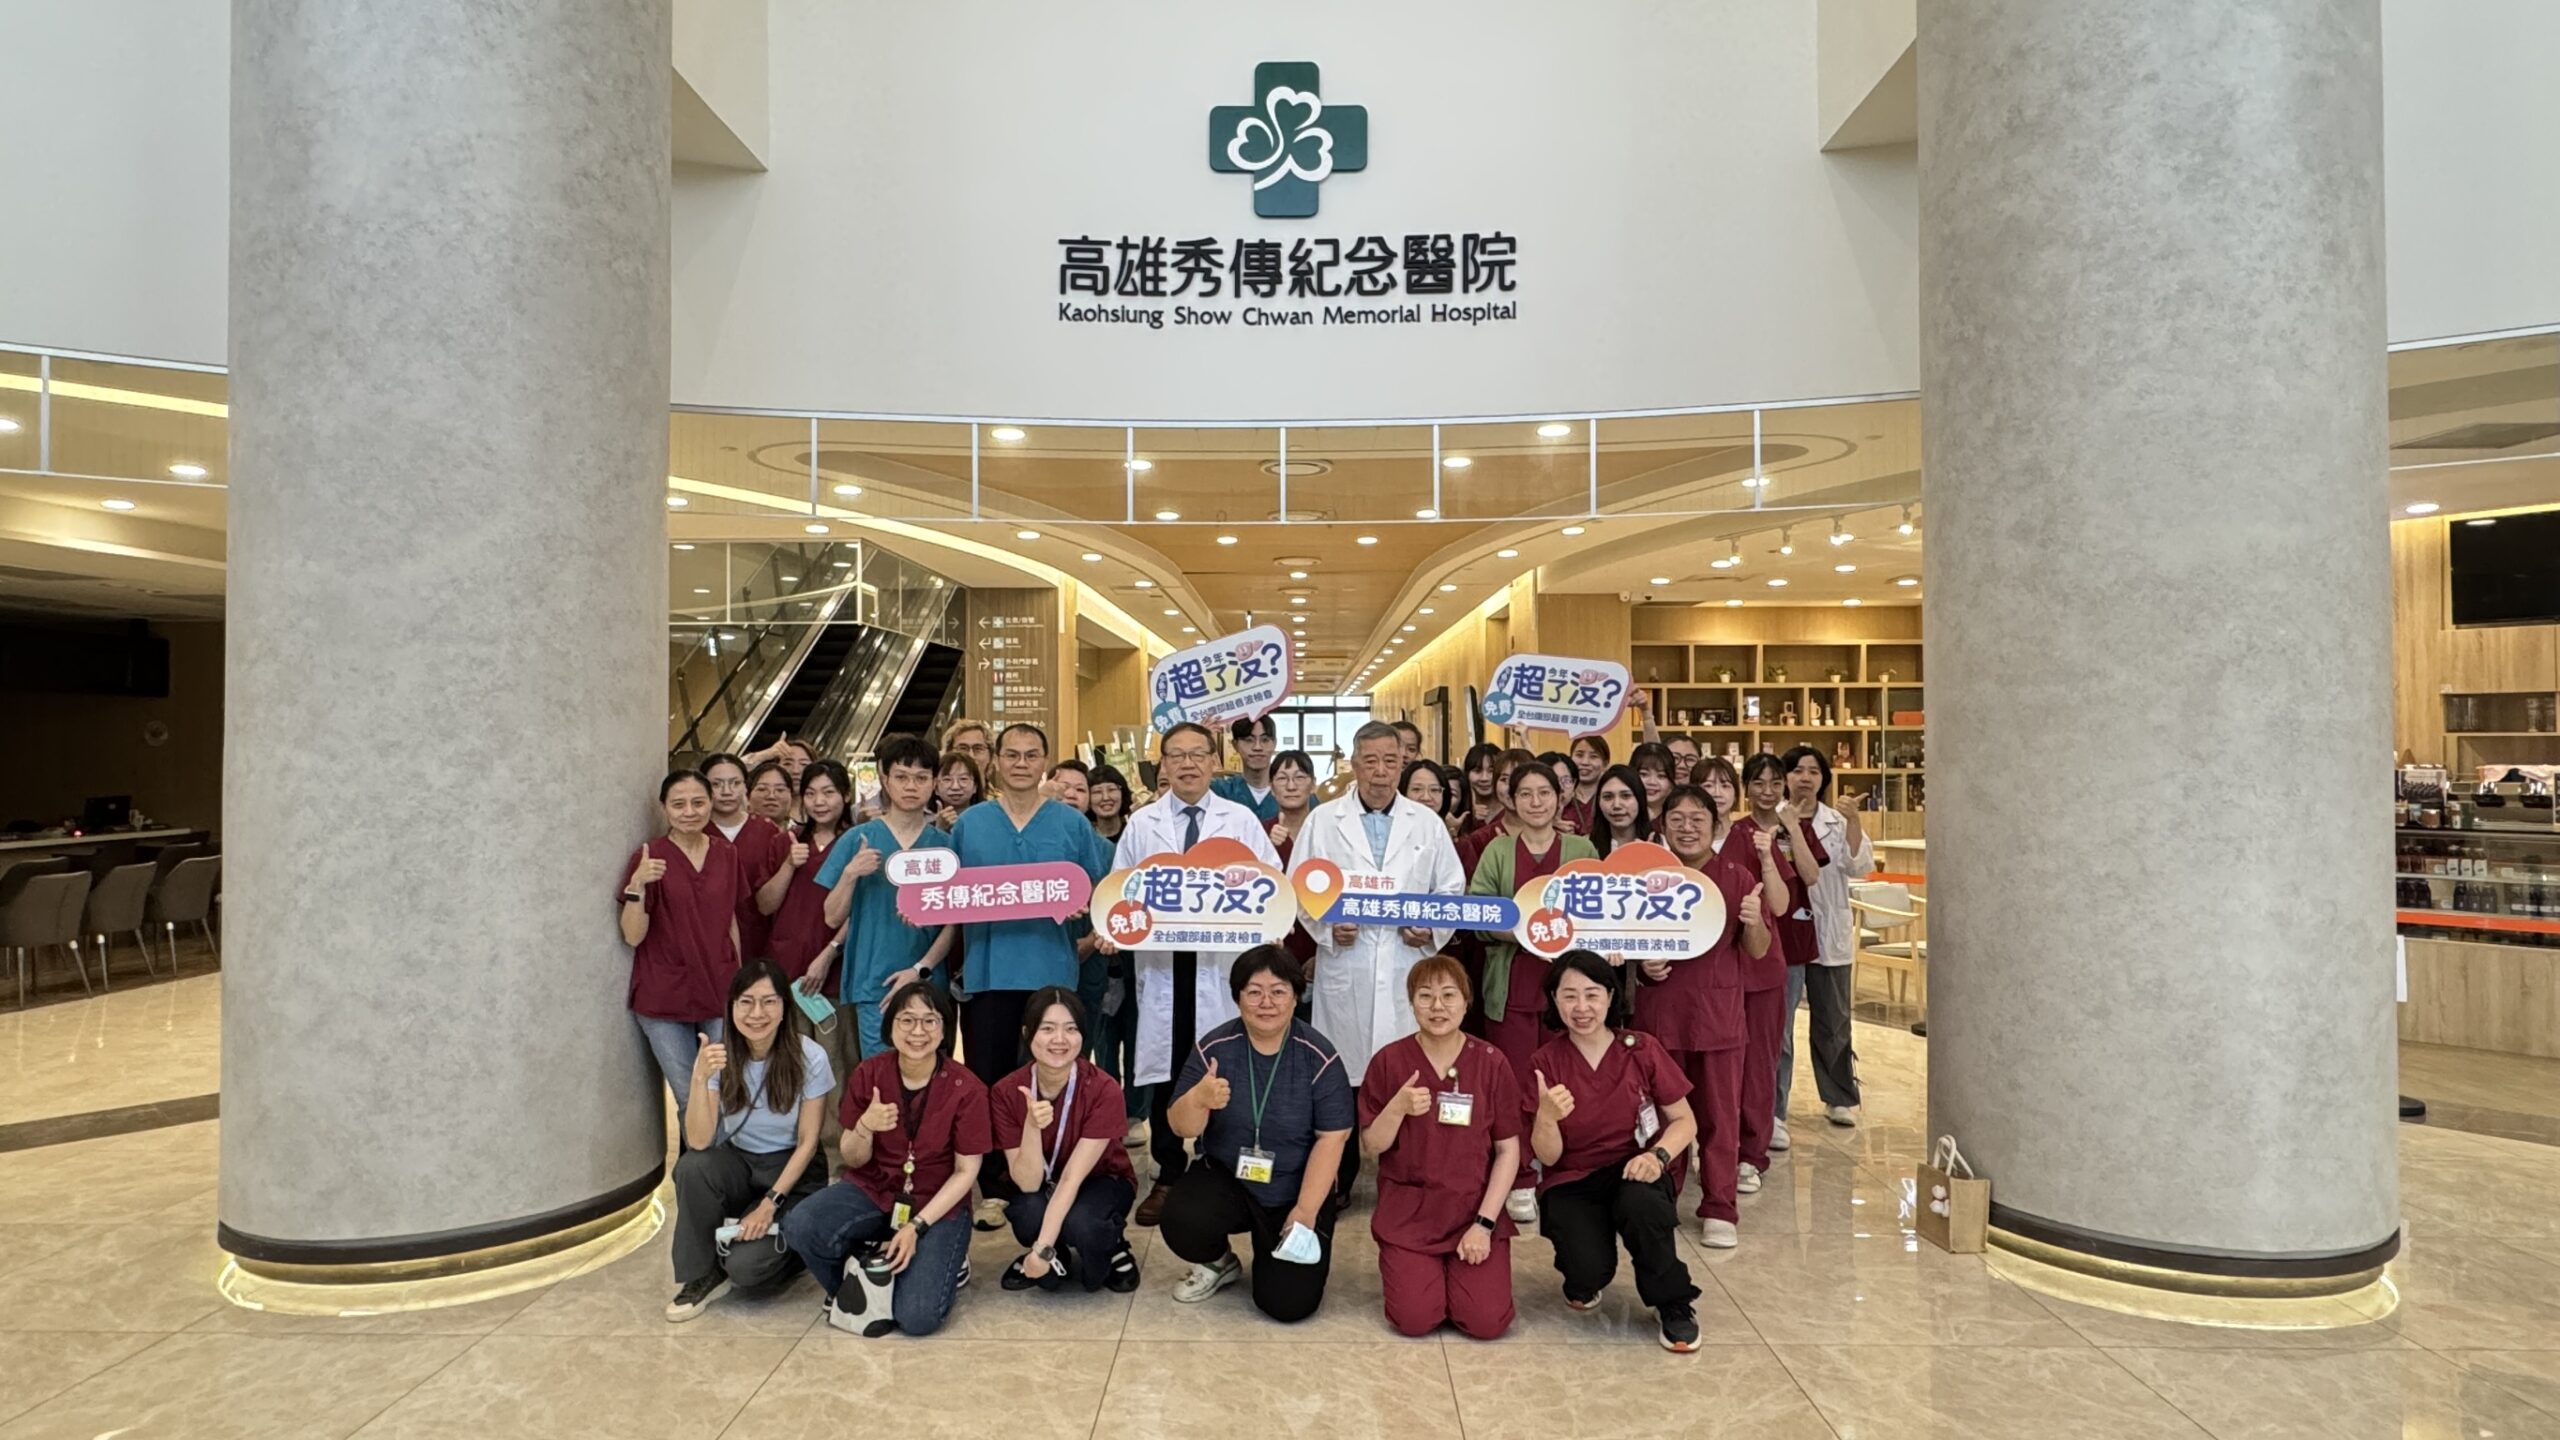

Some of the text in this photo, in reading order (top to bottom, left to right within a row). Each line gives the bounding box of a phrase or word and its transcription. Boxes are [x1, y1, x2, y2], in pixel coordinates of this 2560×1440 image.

[1058, 231, 1517, 298] 高雄秀傳紀念醫院
[1058, 301, 1517, 329] Kaohsiung Show Chwan Memorial Hospital
[1202, 652, 1224, 667] 今年
[1548, 667, 1569, 679] 今年
[1484, 700, 1512, 717] 免費
[1155, 707, 1184, 732] 免費
[904, 858, 942, 876] 高雄
[1186, 870, 1210, 882] 今年
[1348, 874, 1396, 890] 高雄市
[1606, 876, 1632, 888] 今年
[920, 878, 1070, 911] 秀傳紀念醫院
[1342, 897, 1502, 923] 高雄秀傳紀念醫院
[1110, 910, 1148, 936] 免費
[1530, 917, 1570, 943] 免費
[1153, 930, 1263, 944] 全台腹部超音波檢查
[1575, 938, 1690, 952] 全台腹部超音波檢查
